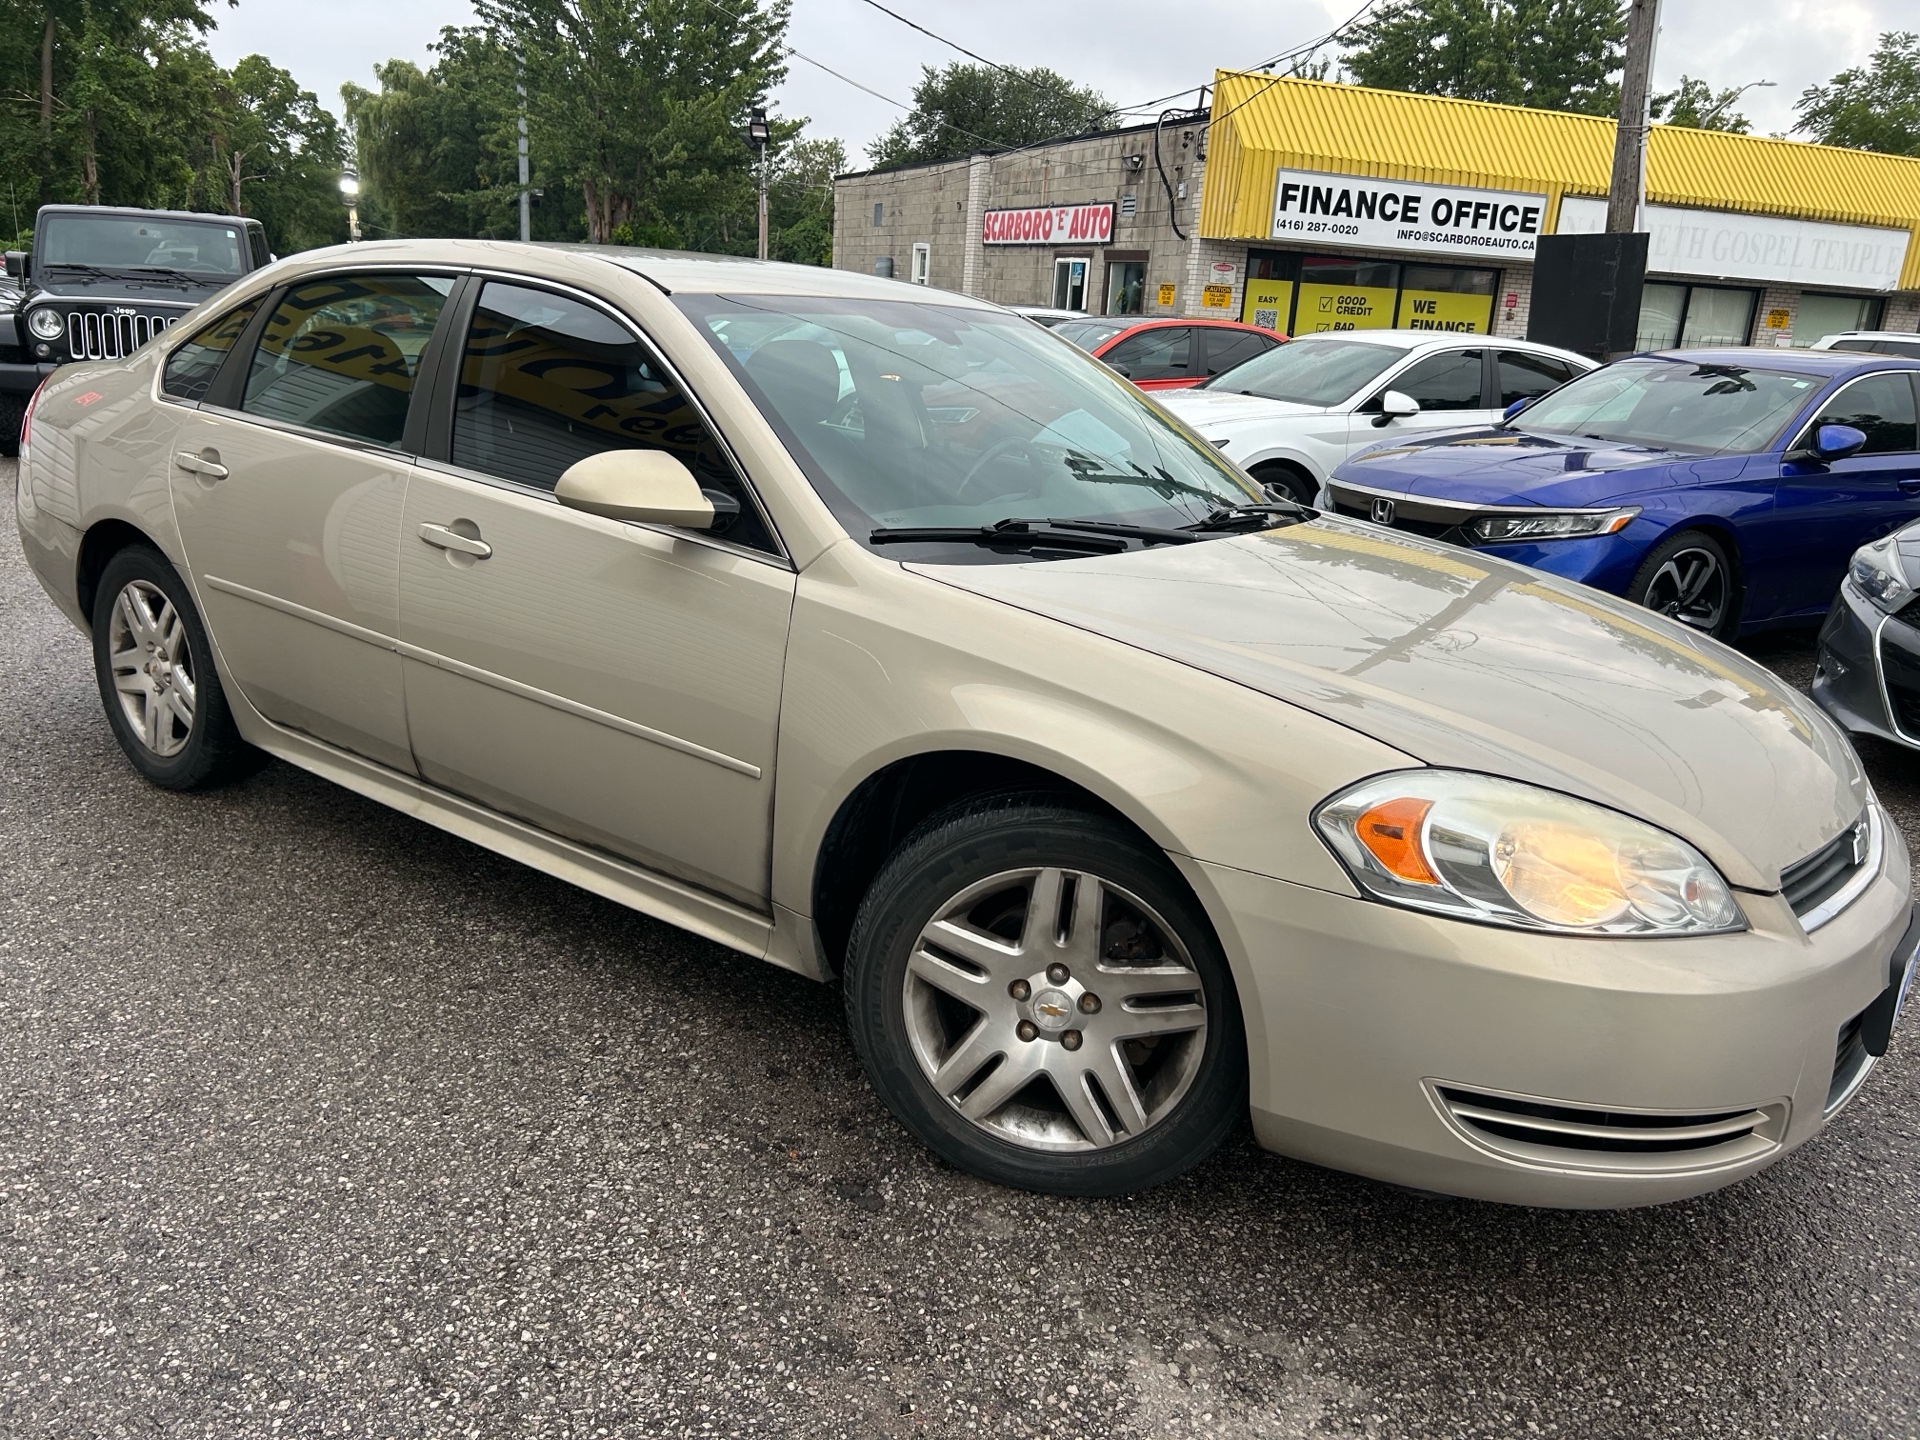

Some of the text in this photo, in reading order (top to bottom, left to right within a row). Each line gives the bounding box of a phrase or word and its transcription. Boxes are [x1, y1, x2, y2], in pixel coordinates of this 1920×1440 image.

[1279, 183, 1540, 234] FINANCE OFFICE
[984, 209, 1053, 241] SCARBORO
[1068, 206, 1111, 239] AUTO
[1276, 218, 1359, 235] (416) 287-0020
[1397, 229, 1535, 250] INFO@SCARBOROEAUTO.CA
[1712, 230, 1804, 269] GOSPEL
[1810, 238, 1902, 276] TEMPLE
[1258, 296, 1278, 304] EASY
[1337, 295, 1367, 306] GOOD
[1413, 299, 1437, 315] WE
[113, 306, 136, 316] Jeep
[1336, 306, 1373, 316] CREDIT
[1333, 322, 1355, 331] BAD
[1410, 318, 1476, 334] FINANCE
